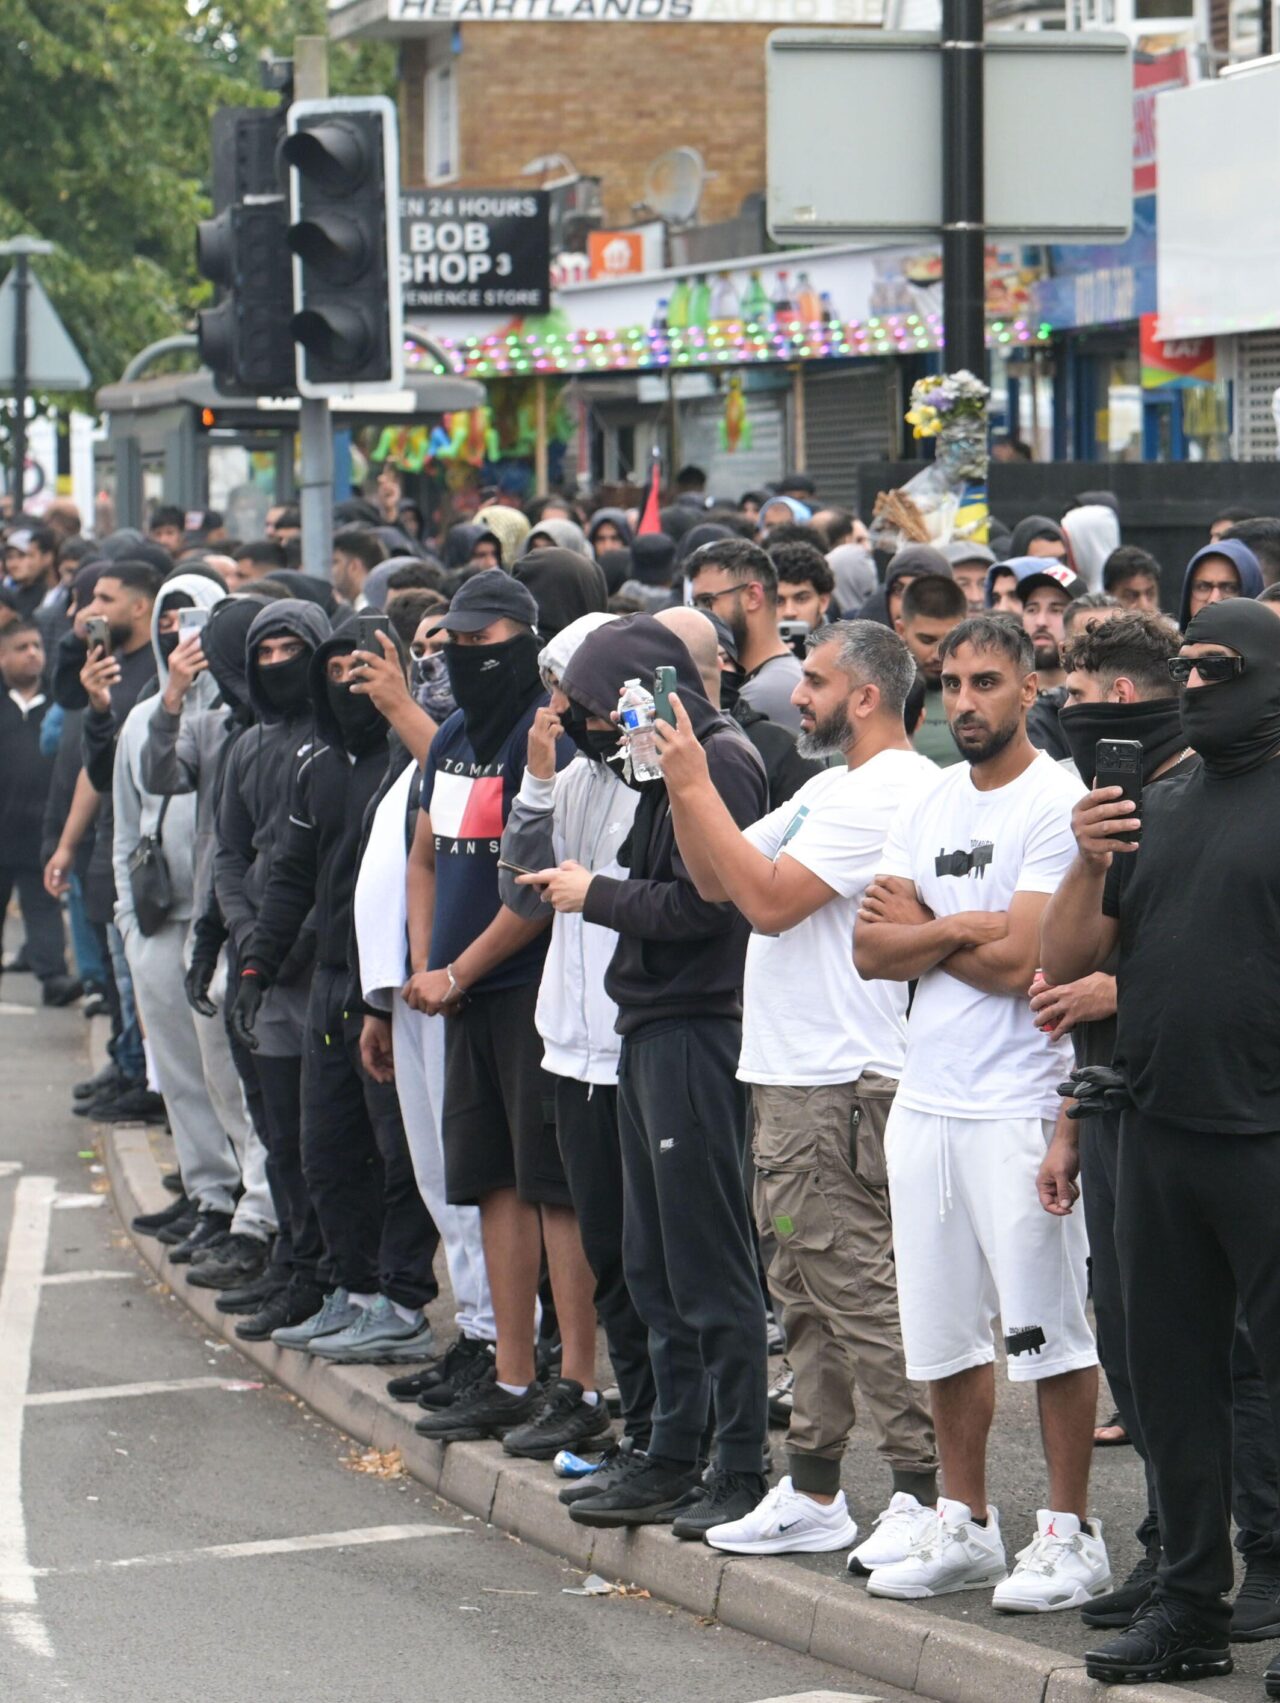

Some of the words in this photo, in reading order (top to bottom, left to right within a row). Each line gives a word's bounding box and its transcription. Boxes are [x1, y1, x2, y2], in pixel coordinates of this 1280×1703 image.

[397, 0, 694, 18] HEARTLANDS
[428, 197, 454, 217] 24
[459, 197, 537, 217] HOURS
[410, 222, 490, 252] BOB
[496, 252, 512, 276] 3
[484, 289, 540, 306] STORE
